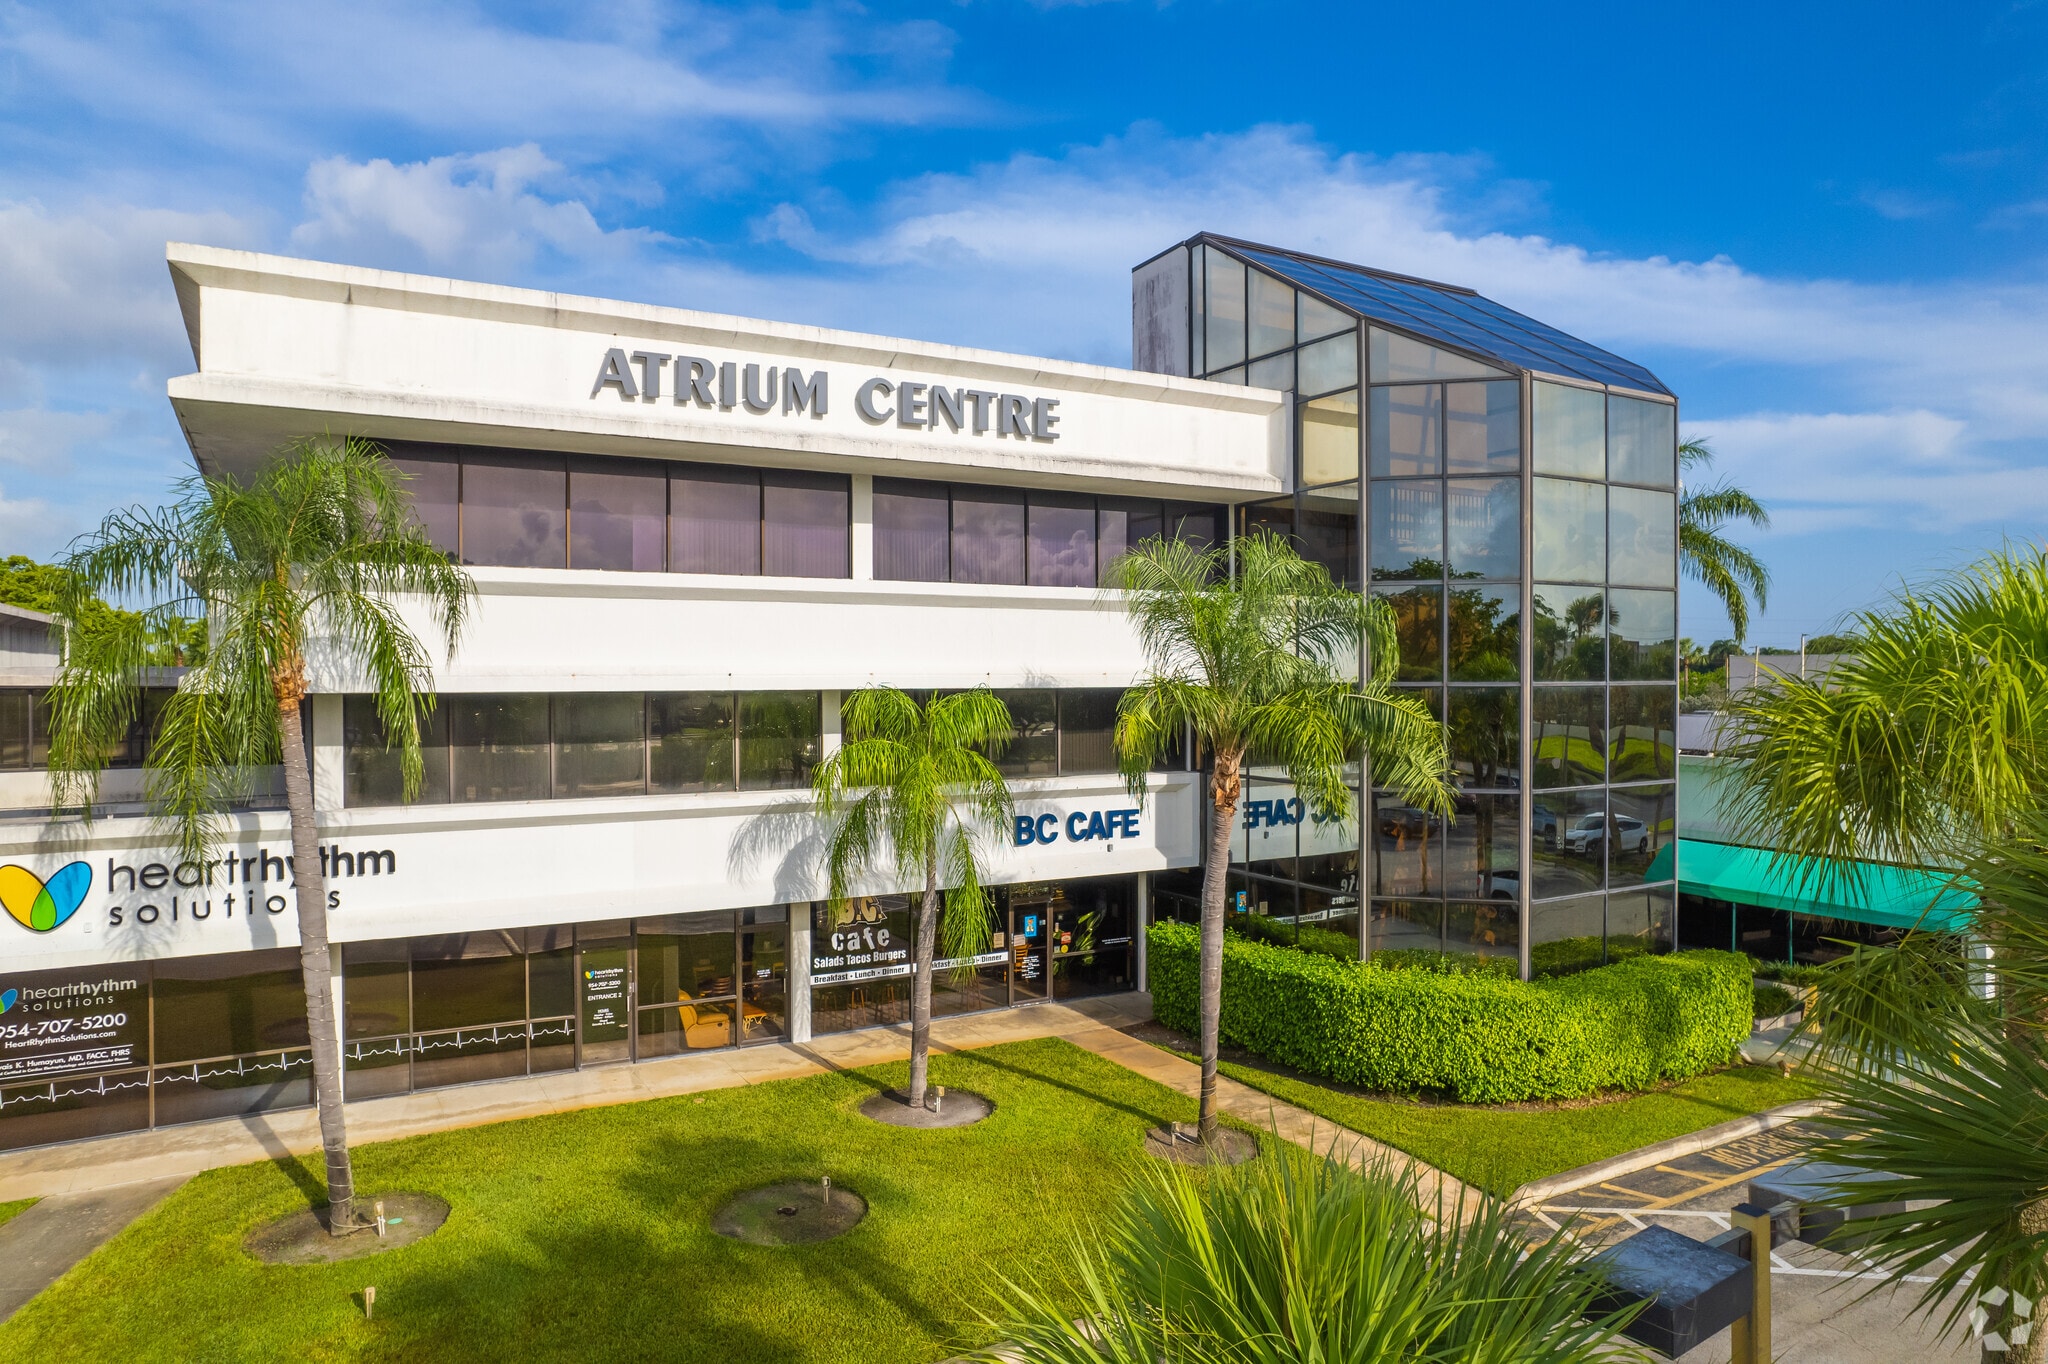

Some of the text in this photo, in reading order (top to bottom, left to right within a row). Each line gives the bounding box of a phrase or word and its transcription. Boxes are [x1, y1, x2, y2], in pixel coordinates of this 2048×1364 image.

[590, 347, 1062, 440] ATRIUM CENTRE
[1014, 809, 1140, 847] BC CAFE
[109, 889, 341, 926] solutios
[831, 927, 890, 951] cafe
[813, 949, 907, 969] Salads Tacos Burgers
[814, 966, 905, 984] Breakfast Lunch Dinner
[22, 979, 137, 1001] heartrhythm
[587, 993, 618, 1001] ENTRANCE
[22, 995, 114, 1013] solutions
[5, 1031, 117, 1049] HeartRhythmSolutions.com
[111, 1048, 131, 1057] FHRS
